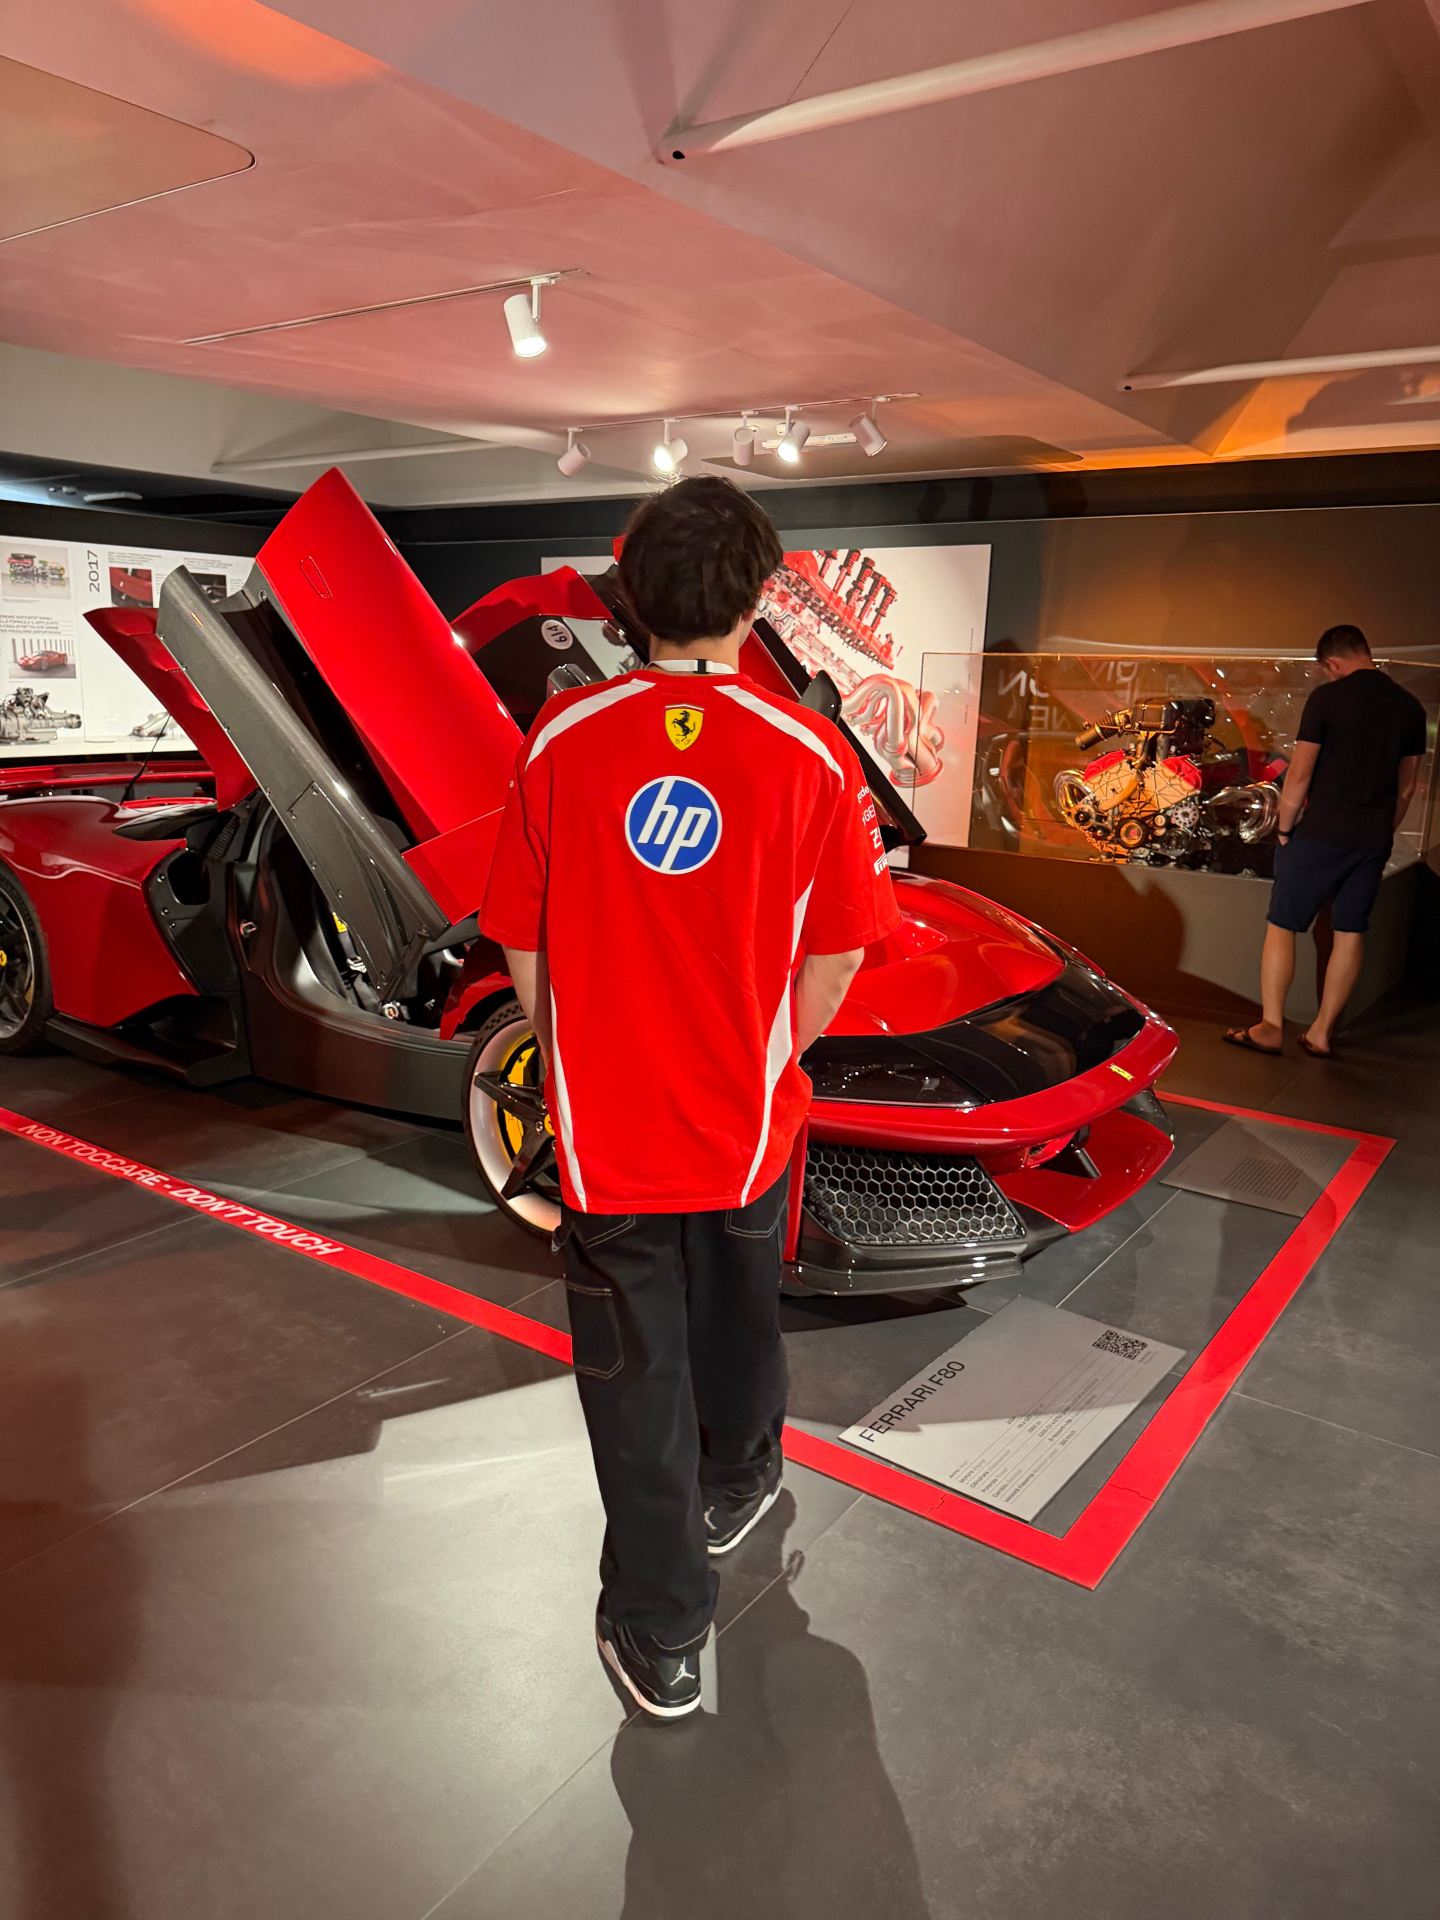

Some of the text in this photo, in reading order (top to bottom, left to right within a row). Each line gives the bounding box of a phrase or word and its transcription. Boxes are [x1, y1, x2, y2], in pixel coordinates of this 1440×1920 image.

[87, 550, 100, 592] 2017
[634, 777, 714, 873] hp
[19, 1124, 71, 1146] NON
[64, 1140, 170, 1187] TOCCARE
[169, 1188, 257, 1218] DON'T
[243, 1215, 345, 1256] TOUCH
[858, 1361, 965, 1443] FERRARI F80
